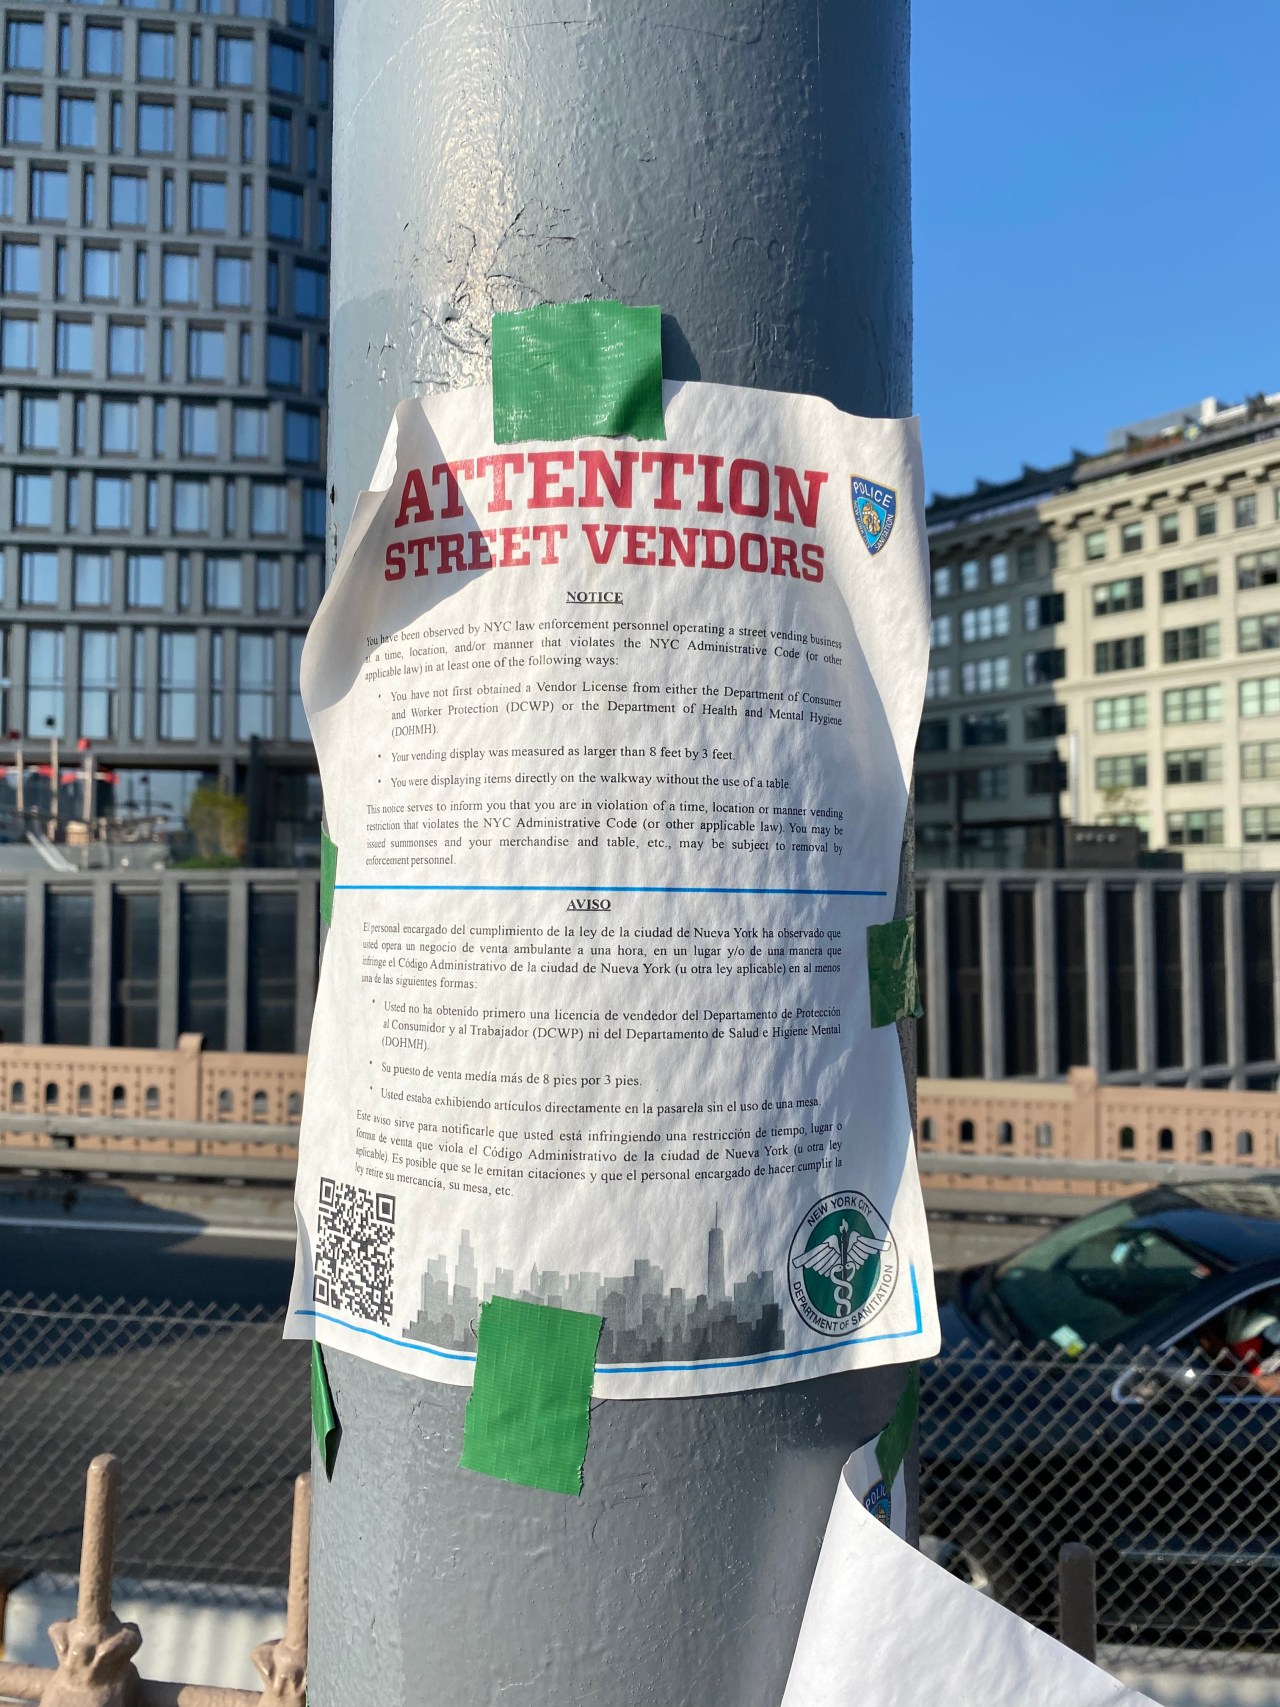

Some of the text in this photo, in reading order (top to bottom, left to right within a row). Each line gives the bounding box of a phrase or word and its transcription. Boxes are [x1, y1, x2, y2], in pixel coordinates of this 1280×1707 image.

[394, 450, 829, 528] ATTENTION
[853, 482, 892, 507] POLICE
[874, 514, 894, 550] SANITATION
[385, 524, 825, 583] STREET VENDORS
[566, 591, 624, 604] NOTICE
[366, 653, 618, 681] applicable law) in at least one of the following ways:
[391, 680, 842, 708] You have not first obtained a Vendor License from either the Department of Consumer
[391, 699, 843, 726] and Worker Protection (DCWP) or the Department of Health and Mental Hygiene
[392, 723, 438, 737] (DOHMH).
[391, 745, 735, 761] Your vending display was measured as larger than 8 feet by 3 feet.
[390, 772, 791, 789] You were displaying items directly on the walkway without the use of a table.
[366, 816, 843, 836] restriction that violates the NYC Administrative Code (or other applicable law). You may be
[567, 900, 611, 910] AVISO
[384, 1000, 841, 1022] Usted no ha obtenido primero una licencia de vendedor del Departamento de Protección
[383, 1018, 841, 1040] al Consumidor y al Trabajador (DCWP) ni del Departamento de Salud e Higiene Mental
[382, 1036, 429, 1052] (DOHMH).
[381, 1061, 642, 1087] Su puesto de venta medía más de 8 pies por 3 pies.
[381, 1087, 821, 1115] Usted estaba exhibiendo artículos directamente en la pasarela sin el uso de una mesa.
[808, 1197, 872, 1227] NEW YORK CITY
[793, 1265, 892, 1330] DEPARTMENT OF SANITATION
